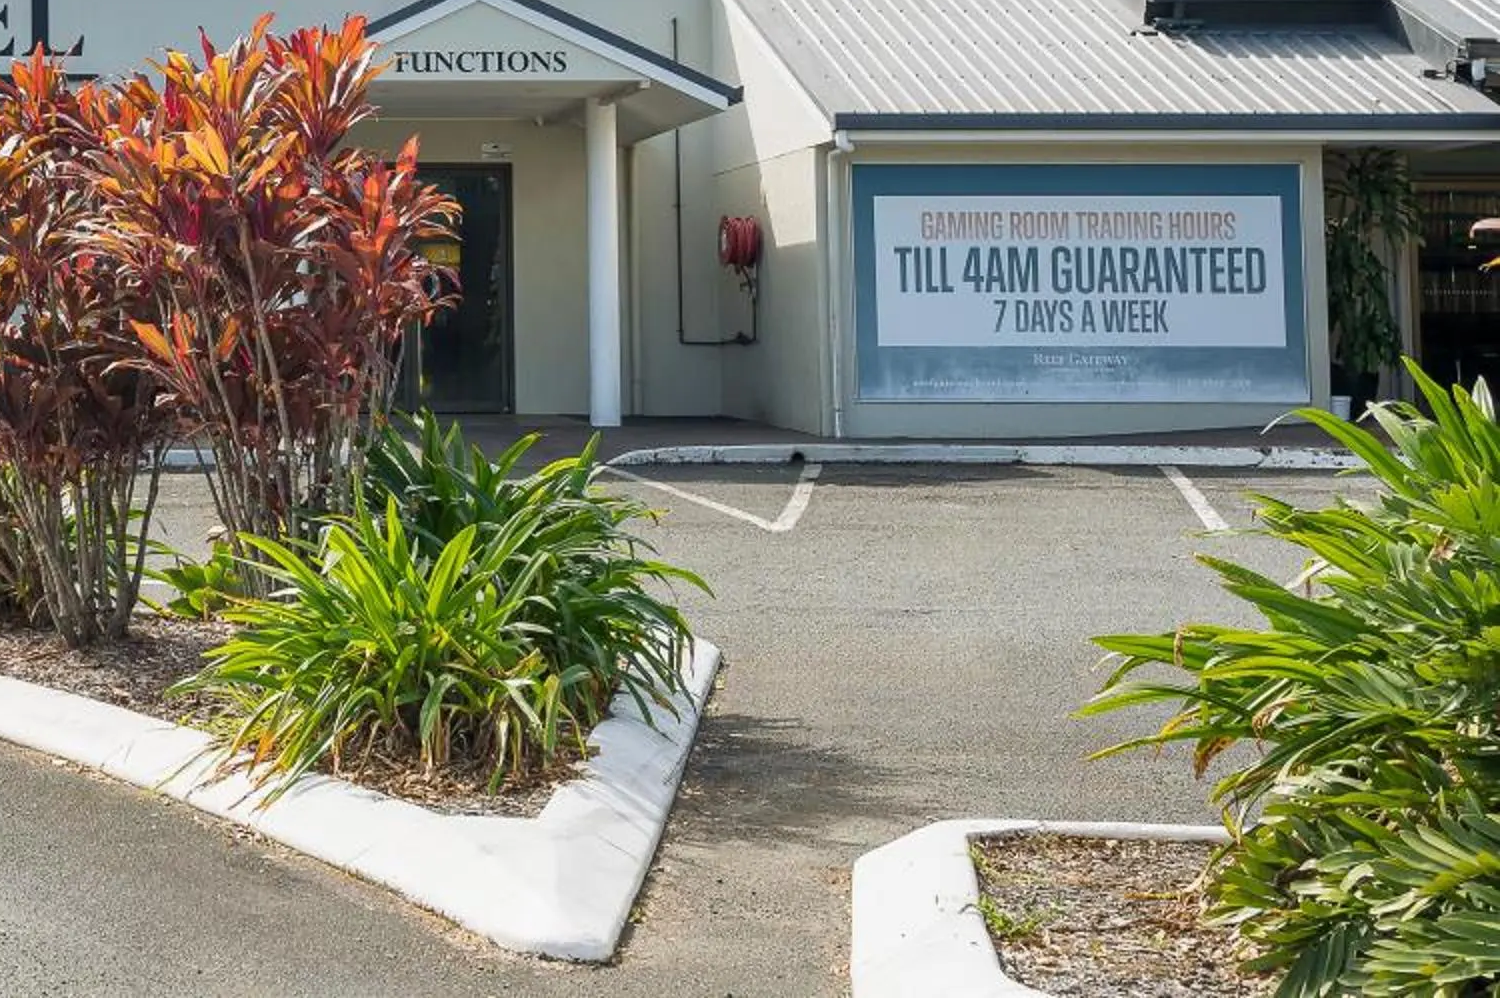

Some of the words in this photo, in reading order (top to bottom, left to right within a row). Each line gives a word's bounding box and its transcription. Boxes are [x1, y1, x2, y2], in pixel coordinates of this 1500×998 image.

[394, 50, 568, 74] FUNCTIONS
[920, 211, 1004, 241] GAMING
[1010, 211, 1070, 241] ROOM
[1076, 211, 1164, 241] TRADING
[1169, 211, 1237, 241] HOURS
[893, 246, 955, 294] TILL
[962, 246, 1040, 294] 4AM
[1050, 246, 1267, 295] GUARANTEED
[993, 300, 1007, 333] 7
[1014, 300, 1074, 334] DAYS
[1080, 300, 1097, 333] A
[1101, 300, 1170, 334] WEEK
